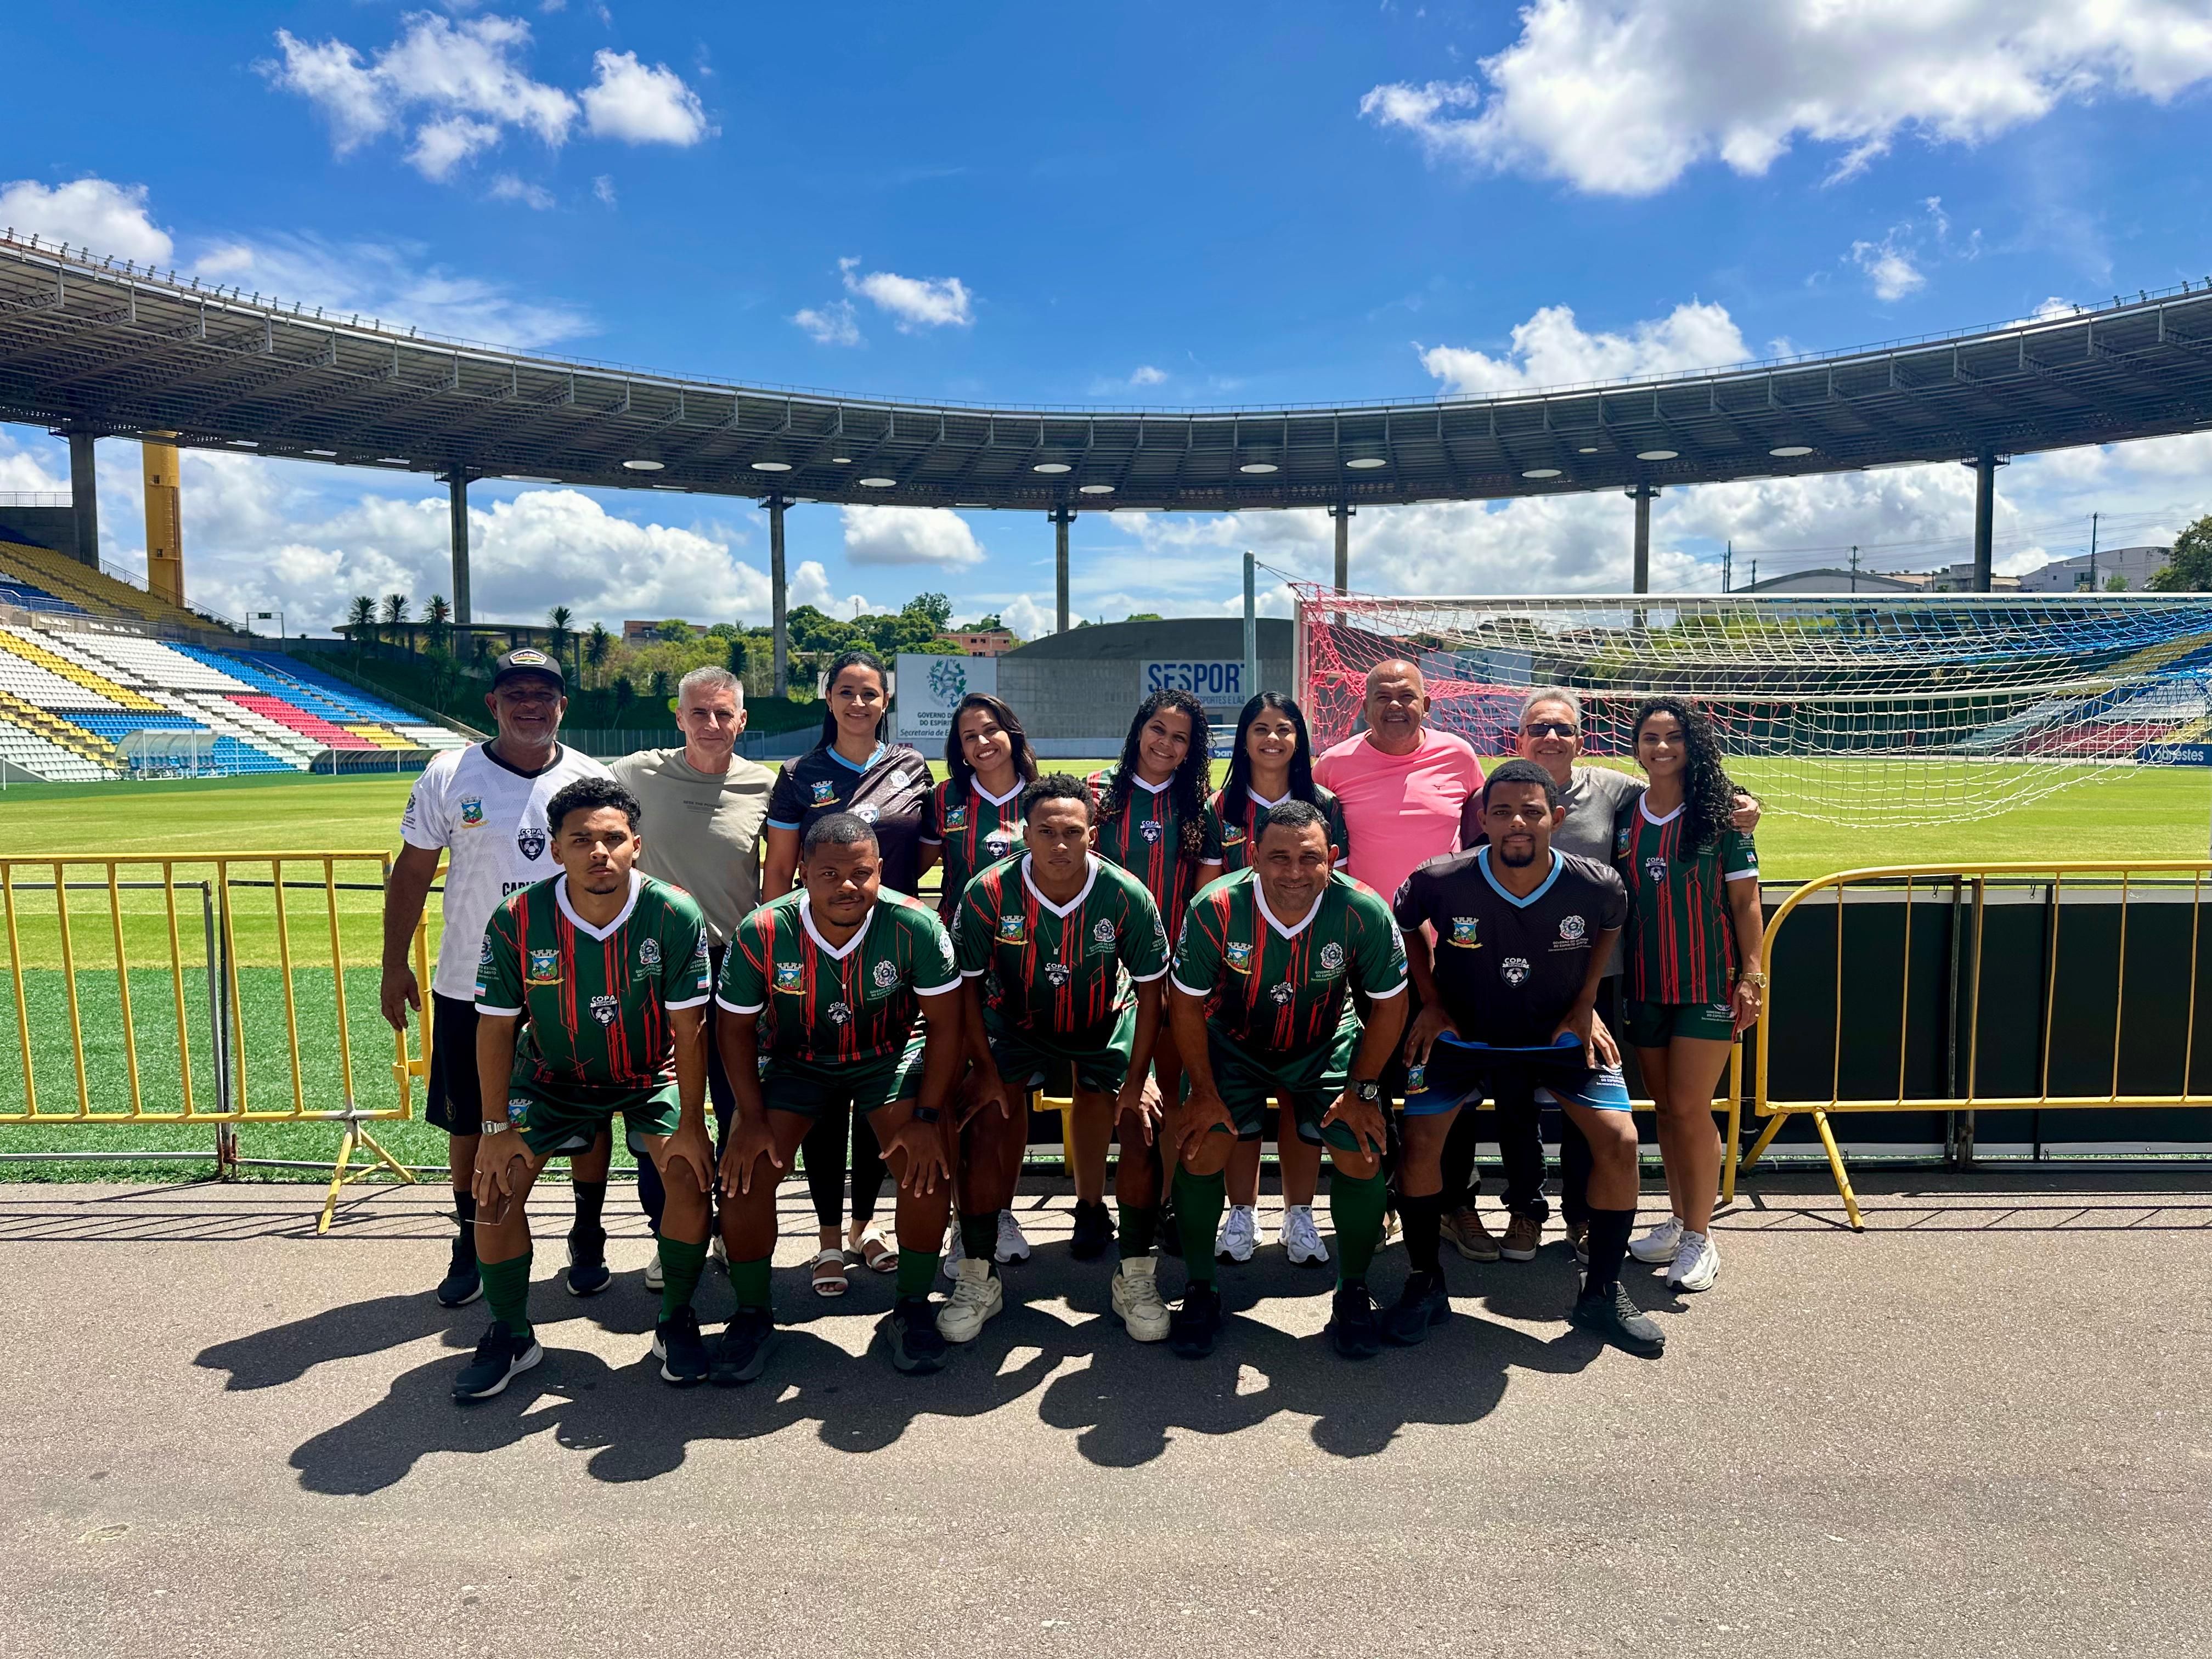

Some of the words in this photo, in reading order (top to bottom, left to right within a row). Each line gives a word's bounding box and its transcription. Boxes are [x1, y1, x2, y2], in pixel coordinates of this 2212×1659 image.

[1228, 696, 1232, 704] E
[1233, 696, 1245, 704] LAZ
[900, 729, 934, 737] Secretaria
[830, 1002, 849, 1011] COPA
